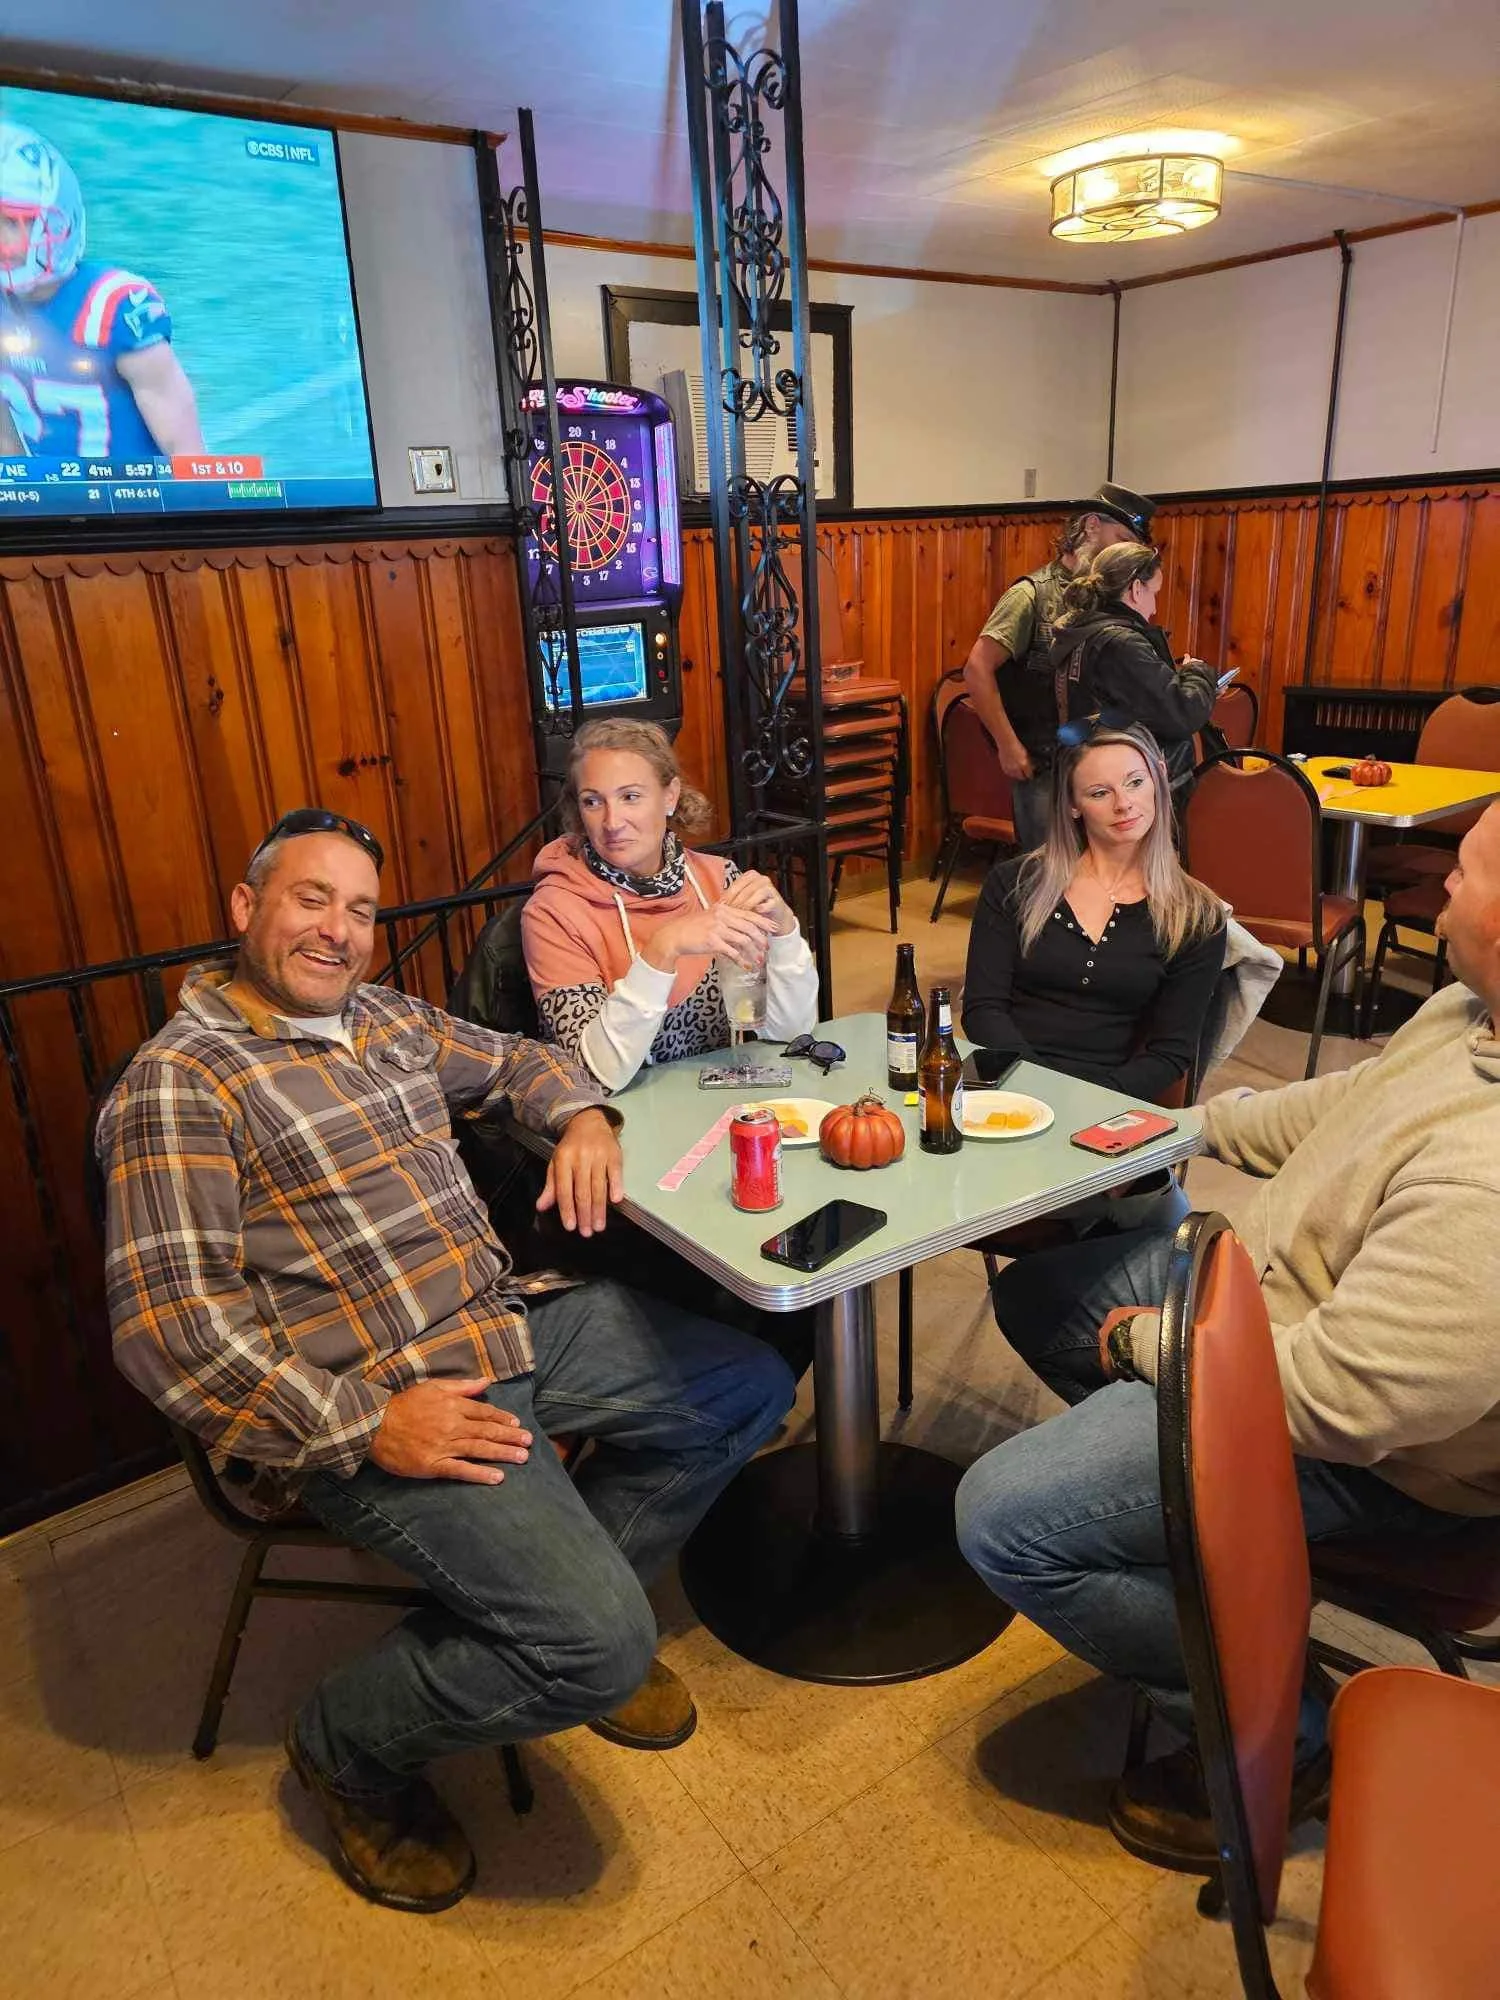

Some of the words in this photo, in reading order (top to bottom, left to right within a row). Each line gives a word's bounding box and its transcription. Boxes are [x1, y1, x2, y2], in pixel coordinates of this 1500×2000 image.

[259, 142, 284, 158] CBS
[289, 146, 315, 161] NFL
[568, 426, 582, 438] 20
[605, 439, 617, 450] 18
[229, 461, 244, 475] 10
[620, 457, 628, 469] 4
[6, 464, 28, 477] NE
[61, 462, 82, 477] 22
[125, 464, 154, 477] 5:57
[158, 465, 173, 475] 34
[629, 477, 641, 489] 13
[88, 488, 100, 500] 21
[114, 488, 135, 499] 4TH
[137, 487, 160, 499] 6:16
[634, 500, 642, 511] 6
[631, 522, 643, 533] 10
[626, 542, 637, 554] 15
[545, 564, 553, 575] 7
[615, 559, 623, 570] 2
[583, 574, 591, 586] 3
[599, 571, 609, 581] 17
